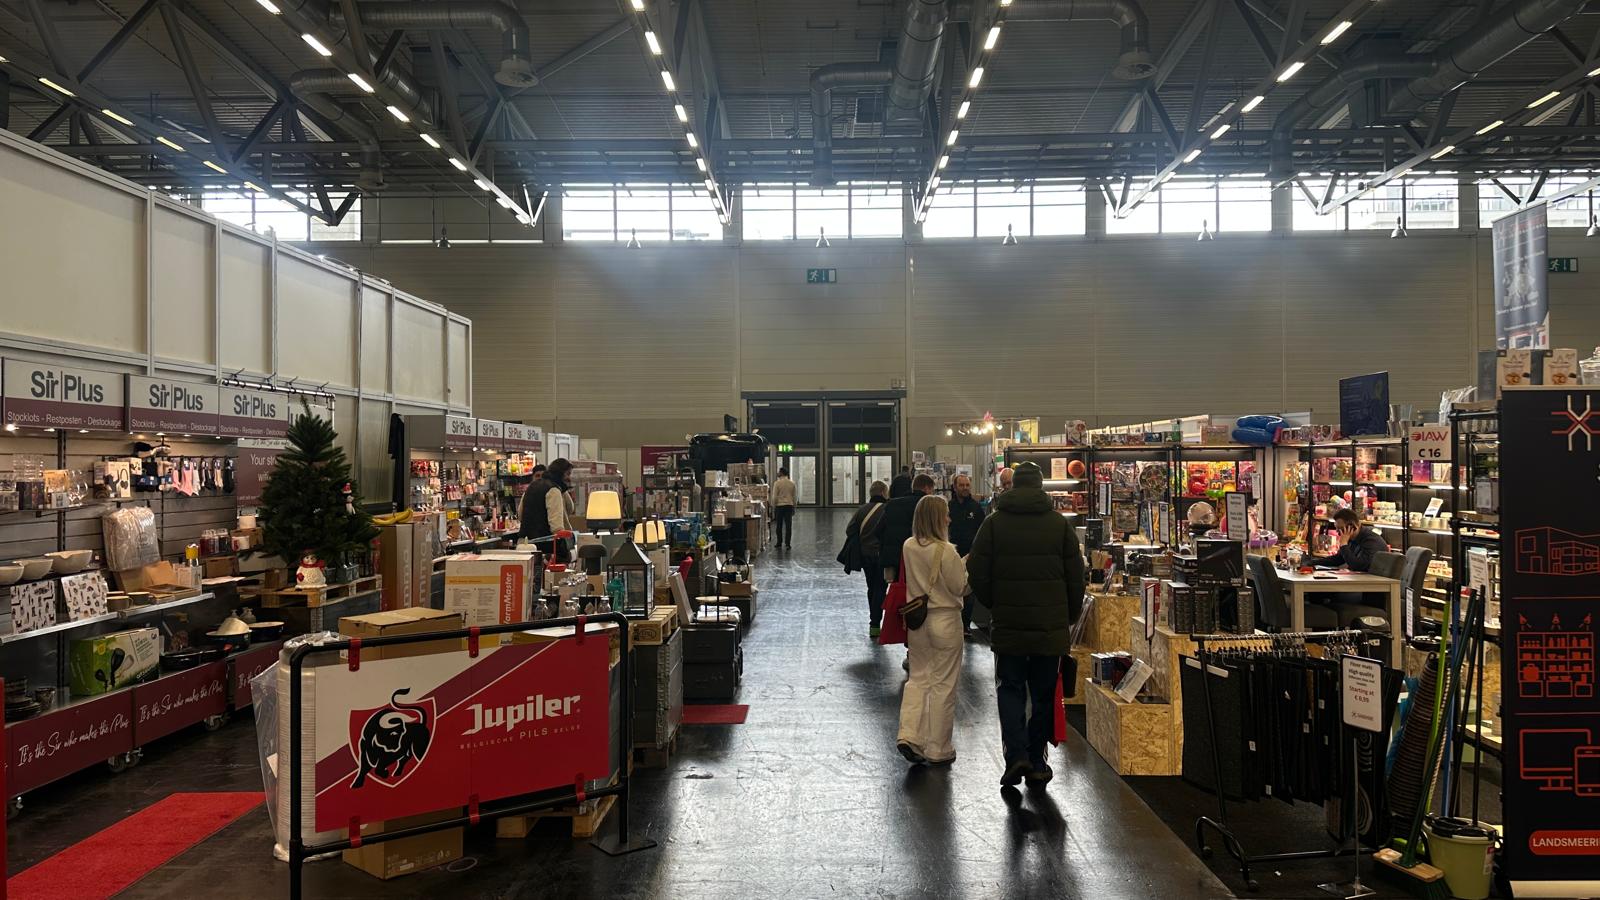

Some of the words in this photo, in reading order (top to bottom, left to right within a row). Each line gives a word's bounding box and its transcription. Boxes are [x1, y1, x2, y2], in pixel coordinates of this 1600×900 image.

[31, 370, 59, 399] Sir
[64, 374, 104, 403] Plus
[149, 383, 170, 408] Sir
[173, 387, 203, 411] Plus
[234, 394, 250, 415] Sir
[252, 397, 276, 418] Plus
[7, 411, 40, 422] Stocklots
[46, 414, 82, 426] Restposten
[131, 418, 156, 428] Stocklots
[160, 420, 187, 430] Restposten
[250, 454, 266, 466] Your
[1418, 448, 1426, 458] C
[1428, 448, 1441, 458] 16
[503, 571, 513, 625] armMaster
[1349, 685, 1368, 696] Starting
[152, 702, 160, 717] the
[161, 694, 171, 715] Sir
[461, 694, 581, 736] Jupiler
[17, 744, 33, 767] It's
[35, 741, 46, 759] the
[47, 731, 62, 756] Sir
[63, 730, 78, 748] who
[79, 724, 98, 742] makes
[99, 719, 109, 736] the
[109, 713, 129, 734] Plus
[460, 736, 513, 750] BELGISCHE
[519, 727, 548, 740] PILS
[1532, 837, 1600, 847] LANDSMEERI
